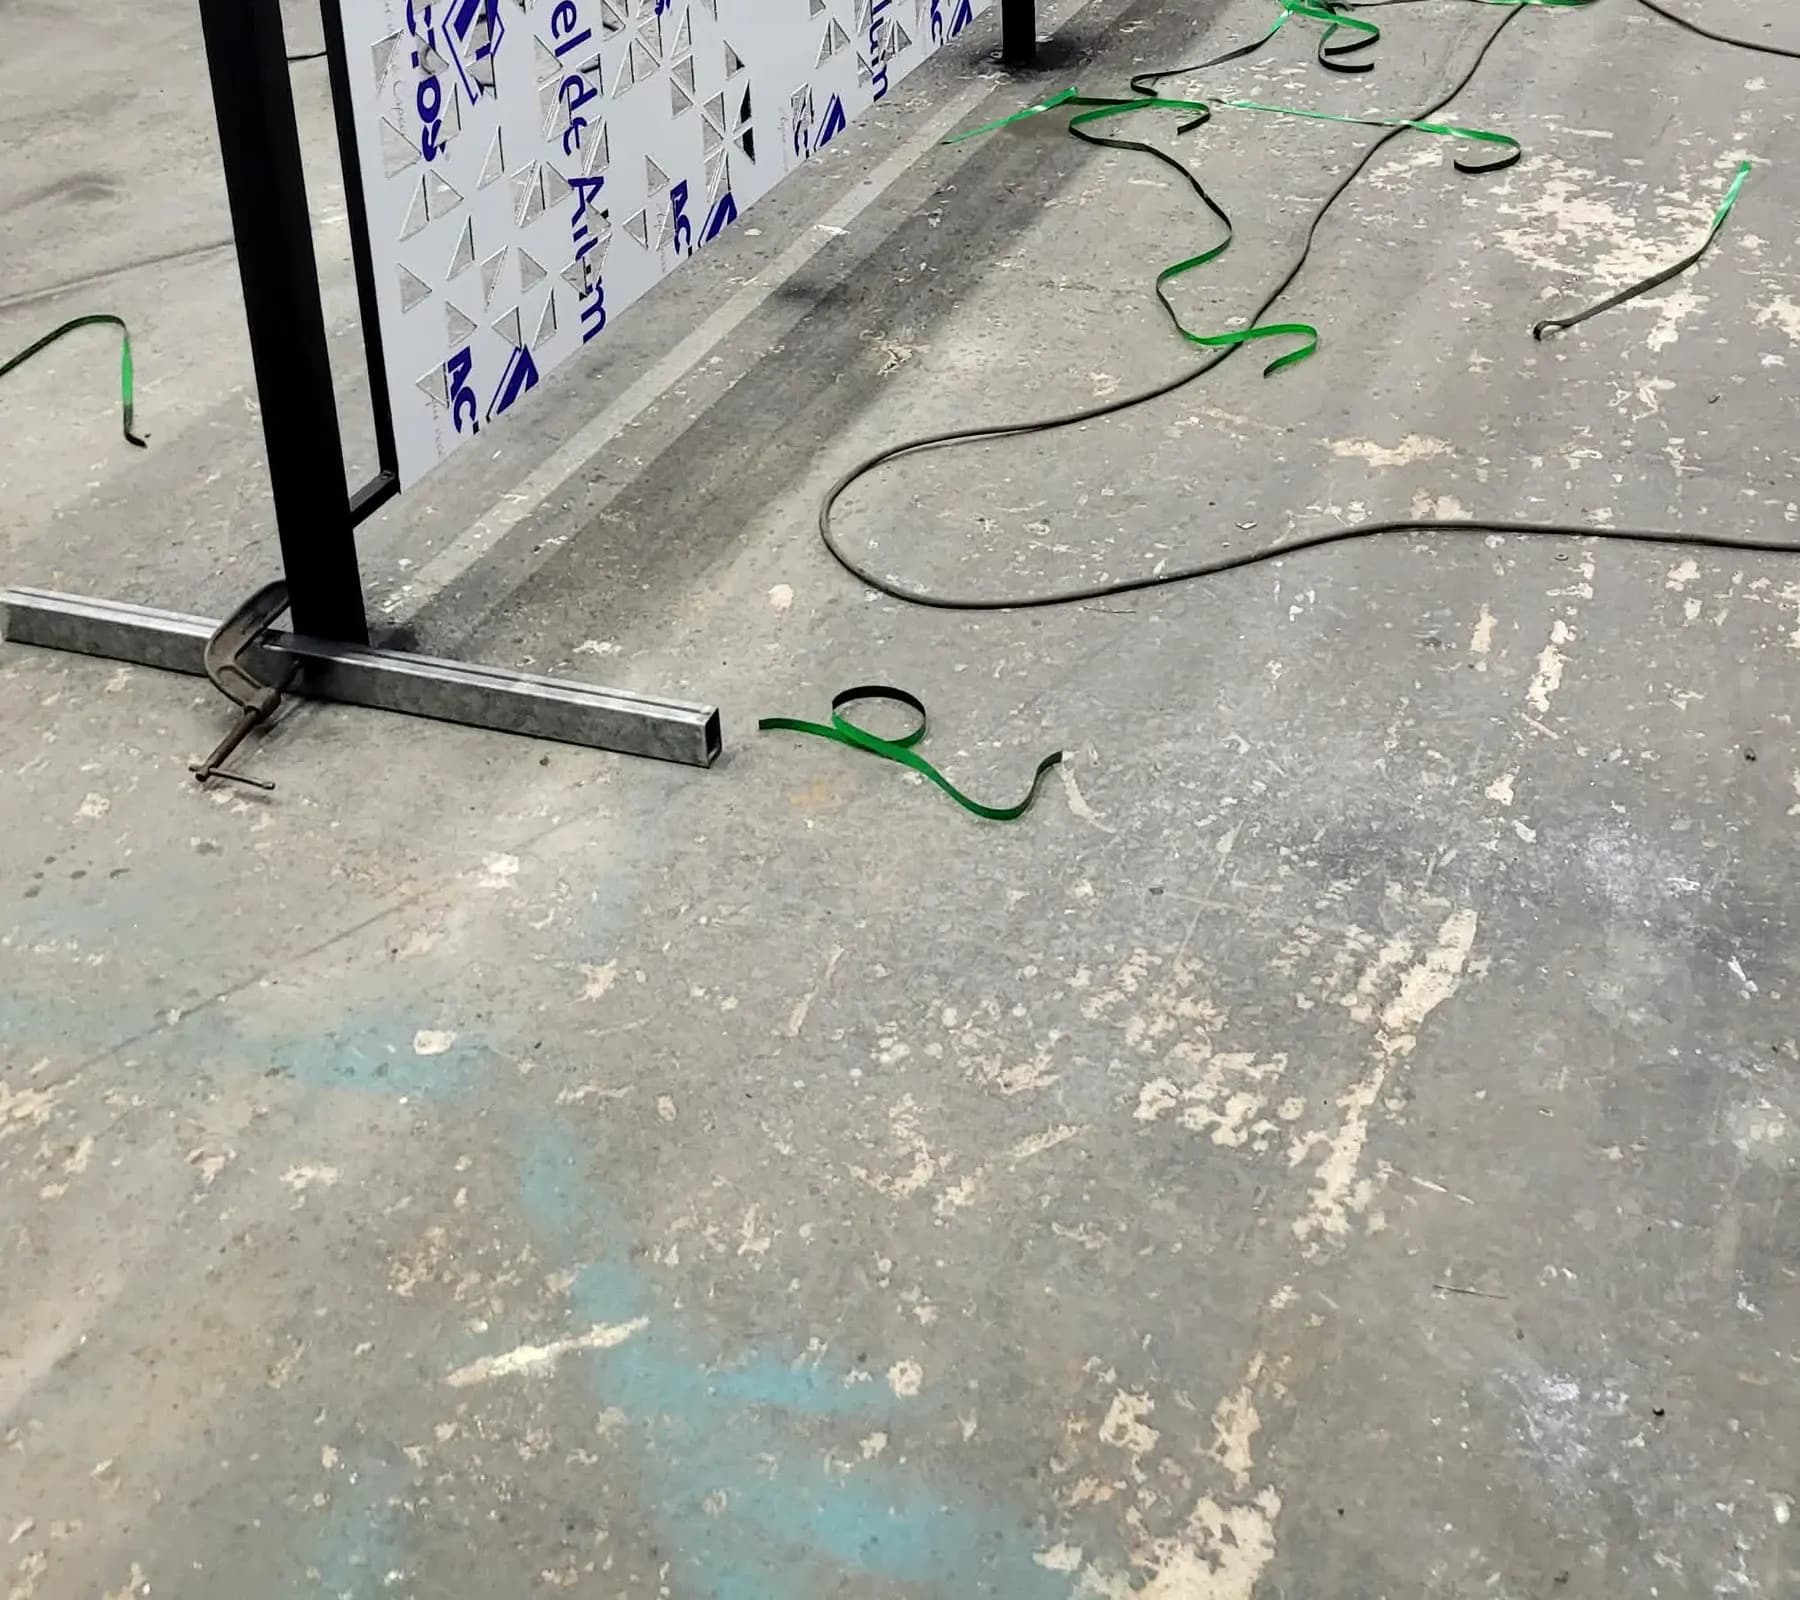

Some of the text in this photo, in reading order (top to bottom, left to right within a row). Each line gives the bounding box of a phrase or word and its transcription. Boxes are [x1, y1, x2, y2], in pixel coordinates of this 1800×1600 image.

[558, 74, 599, 156] de
[668, 179, 693, 258] AC
[446, 345, 480, 435] AC
